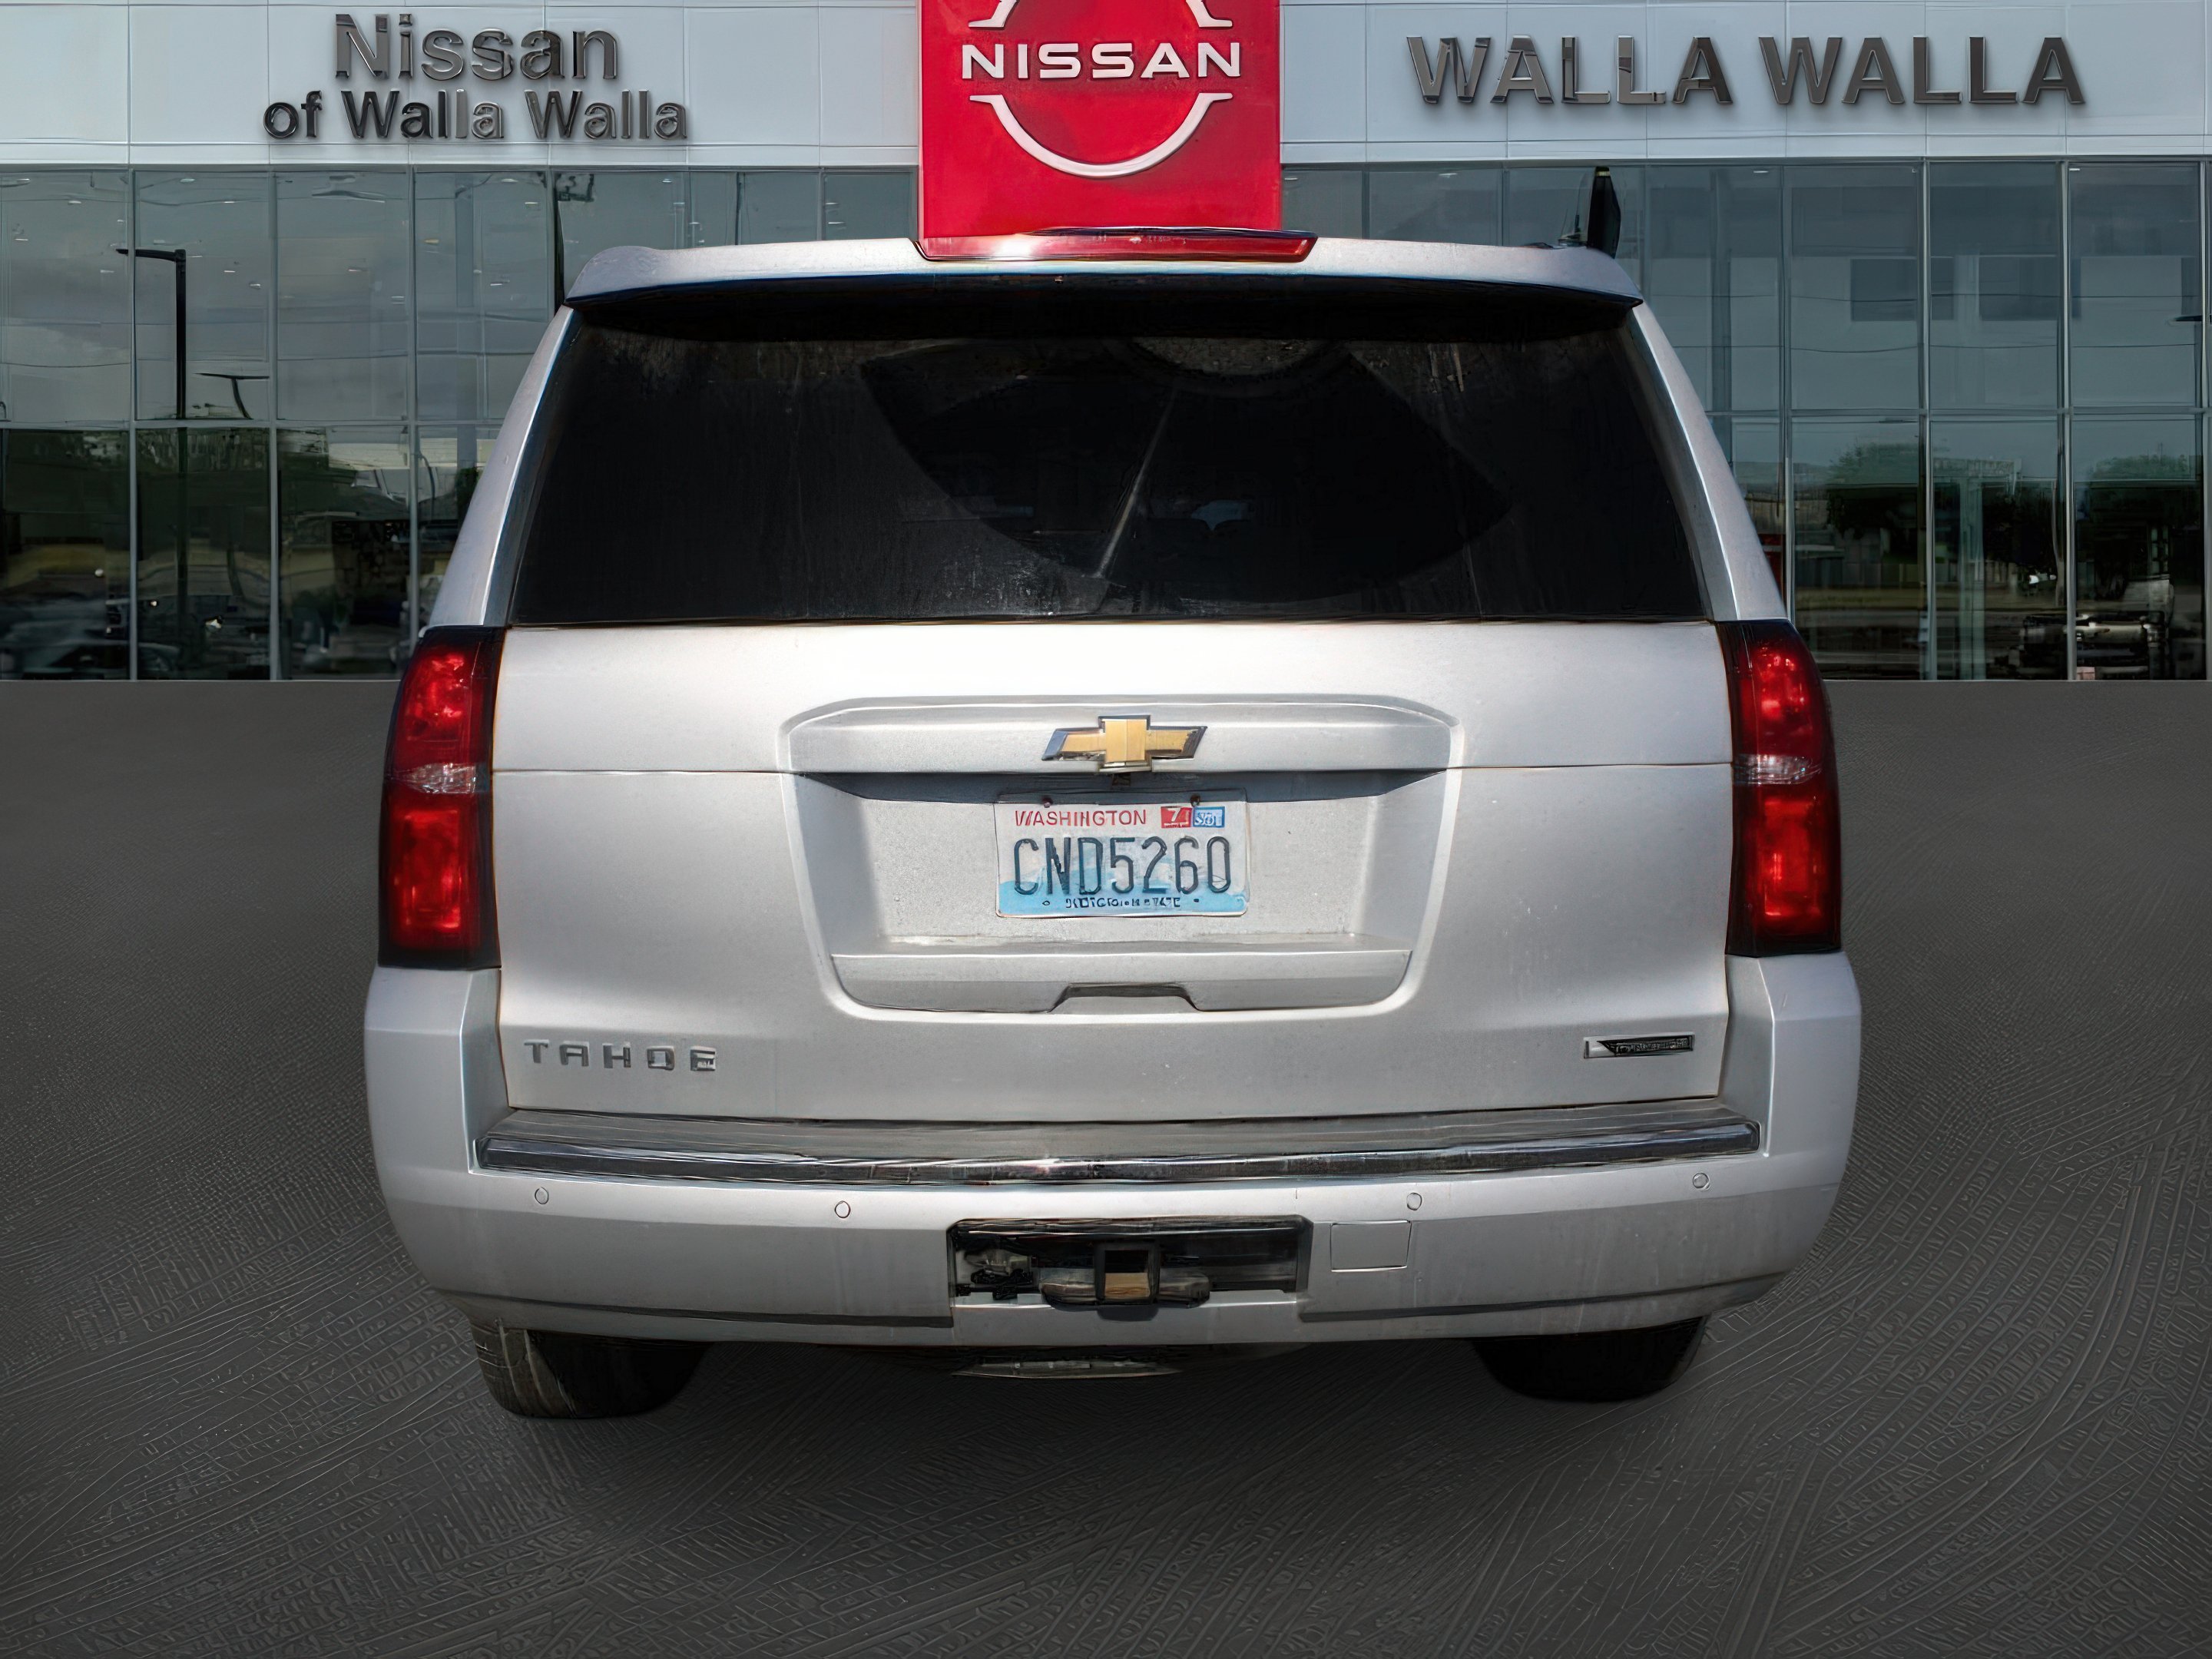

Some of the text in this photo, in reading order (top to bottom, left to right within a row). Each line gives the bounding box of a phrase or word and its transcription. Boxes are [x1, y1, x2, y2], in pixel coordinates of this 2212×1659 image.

[335, 13, 619, 80] Nissan
[962, 41, 1241, 79] NISSAN
[1406, 35, 2087, 105] WALLA WALLA
[262, 89, 687, 140] of Walla Walla
[1015, 809, 1147, 827] WASHINGTON
[1013, 835, 1231, 895] CND5260
[524, 1038, 717, 1071] TAHOE
